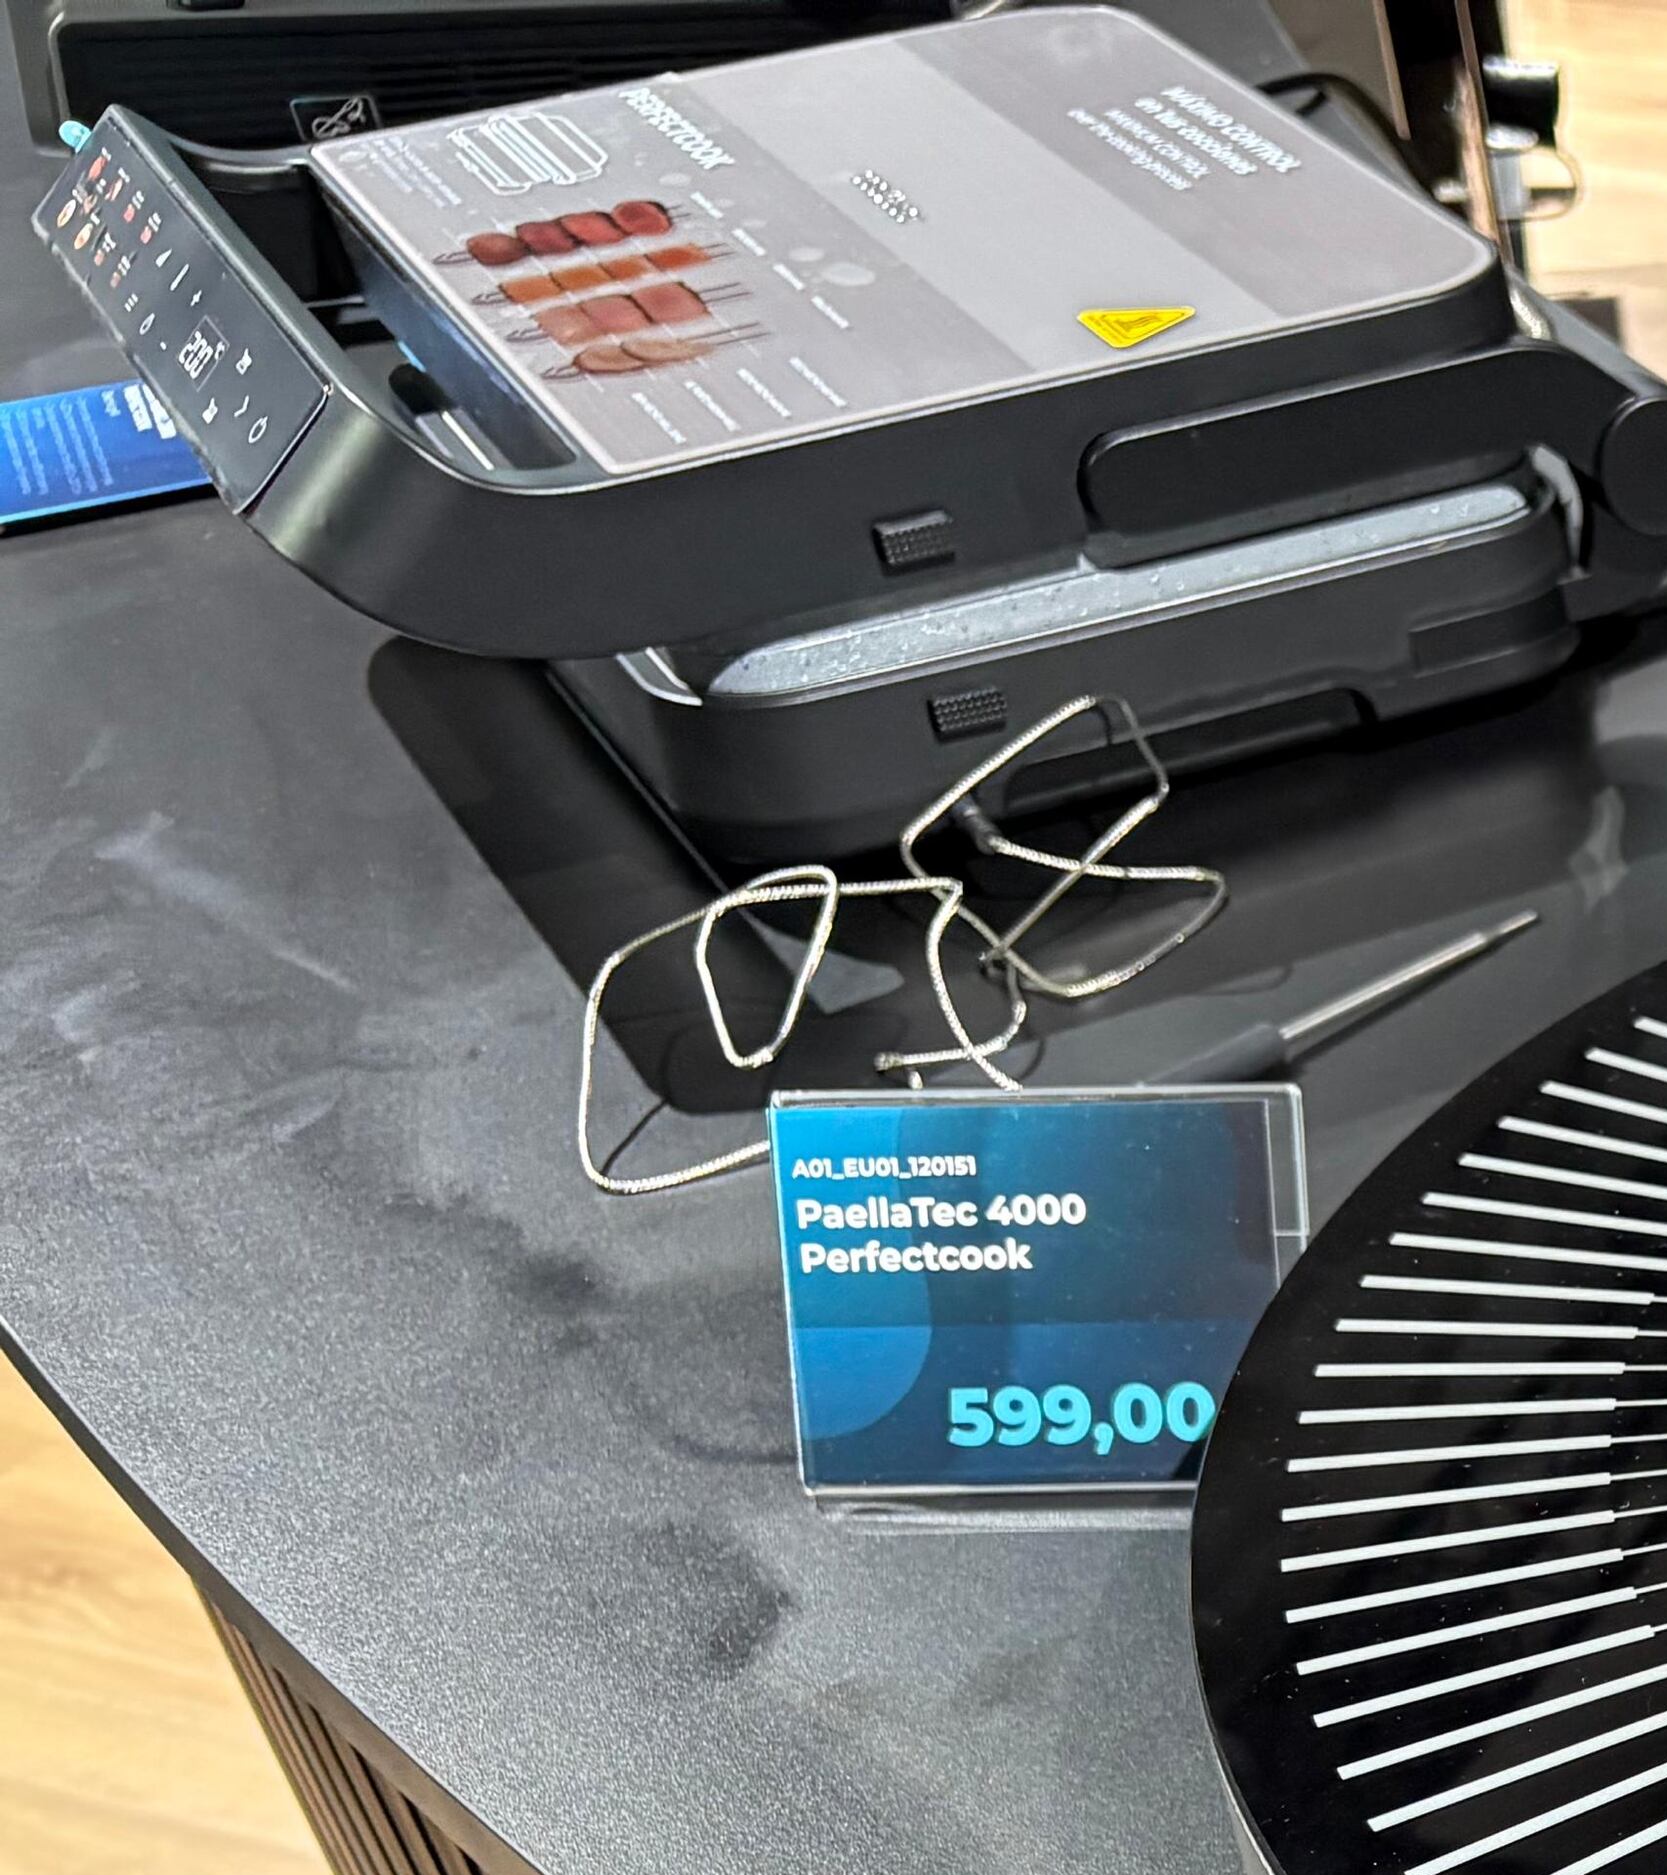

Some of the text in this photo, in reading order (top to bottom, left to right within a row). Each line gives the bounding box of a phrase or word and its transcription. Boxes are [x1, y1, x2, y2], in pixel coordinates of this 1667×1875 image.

[791, 1155, 976, 1179] A01_EU01_120151
[797, 1193, 1087, 1229] PaellaTec 4000
[800, 1237, 1034, 1273] Perfectcook
[948, 1382, 1216, 1456] 599,00
